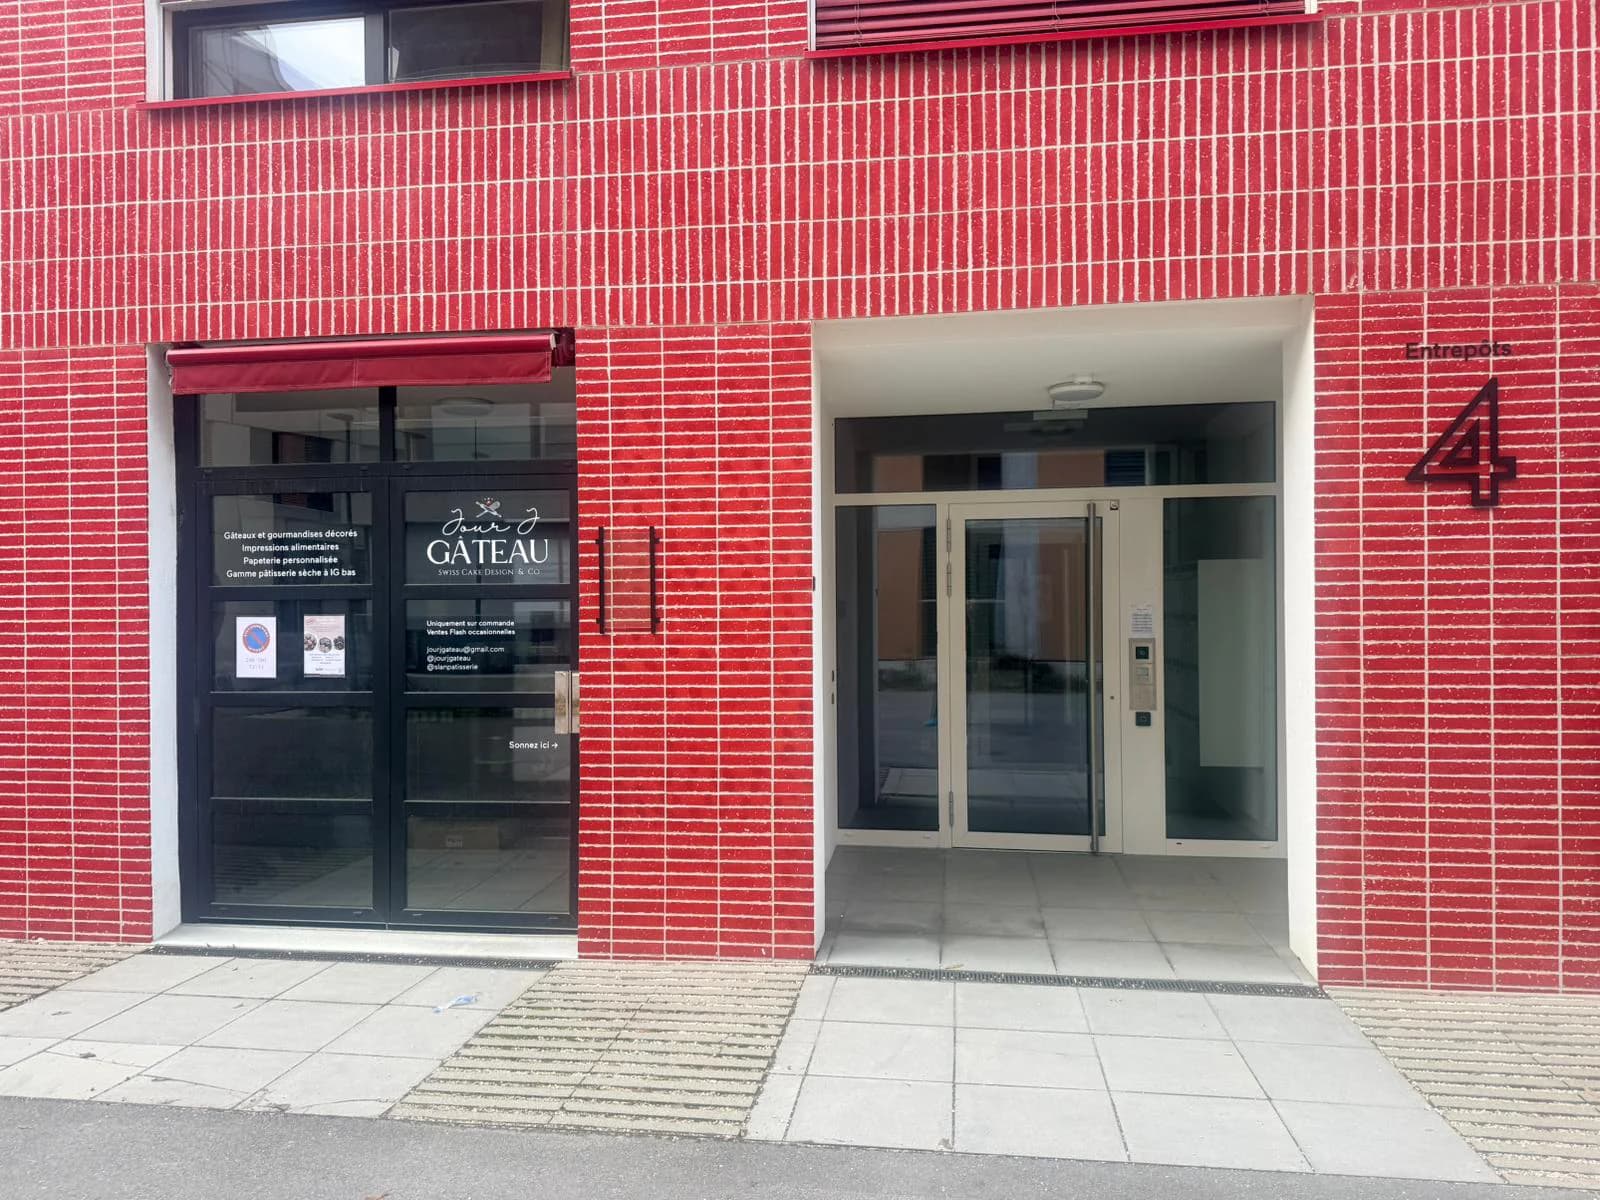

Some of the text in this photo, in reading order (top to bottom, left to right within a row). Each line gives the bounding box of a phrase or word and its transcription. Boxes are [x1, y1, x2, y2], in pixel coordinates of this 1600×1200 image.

[1405, 339, 1512, 361] Entrepôts
[1405, 377, 1517, 507] 4
[442, 507, 541, 536] Jour J
[224, 528, 358, 540] Gâteaux et gourmandises décorés
[242, 542, 339, 553] Impressions alimentaires
[426, 536, 550, 565] GÂTEAU
[243, 555, 338, 565] Papeterie personnalisée
[226, 567, 356, 578] Gamme pâtisserie sèche à IG bas
[518, 567, 525, 576] &
[426, 620, 466, 628] Uniquement
[449, 628, 467, 636] Flash
[467, 628, 516, 636] occasionnelles
[426, 645, 505, 655] jourjgateau@gmail.com
[426, 655, 471, 663] @jourjgateau
[508, 740, 550, 749] Sonnez ici
